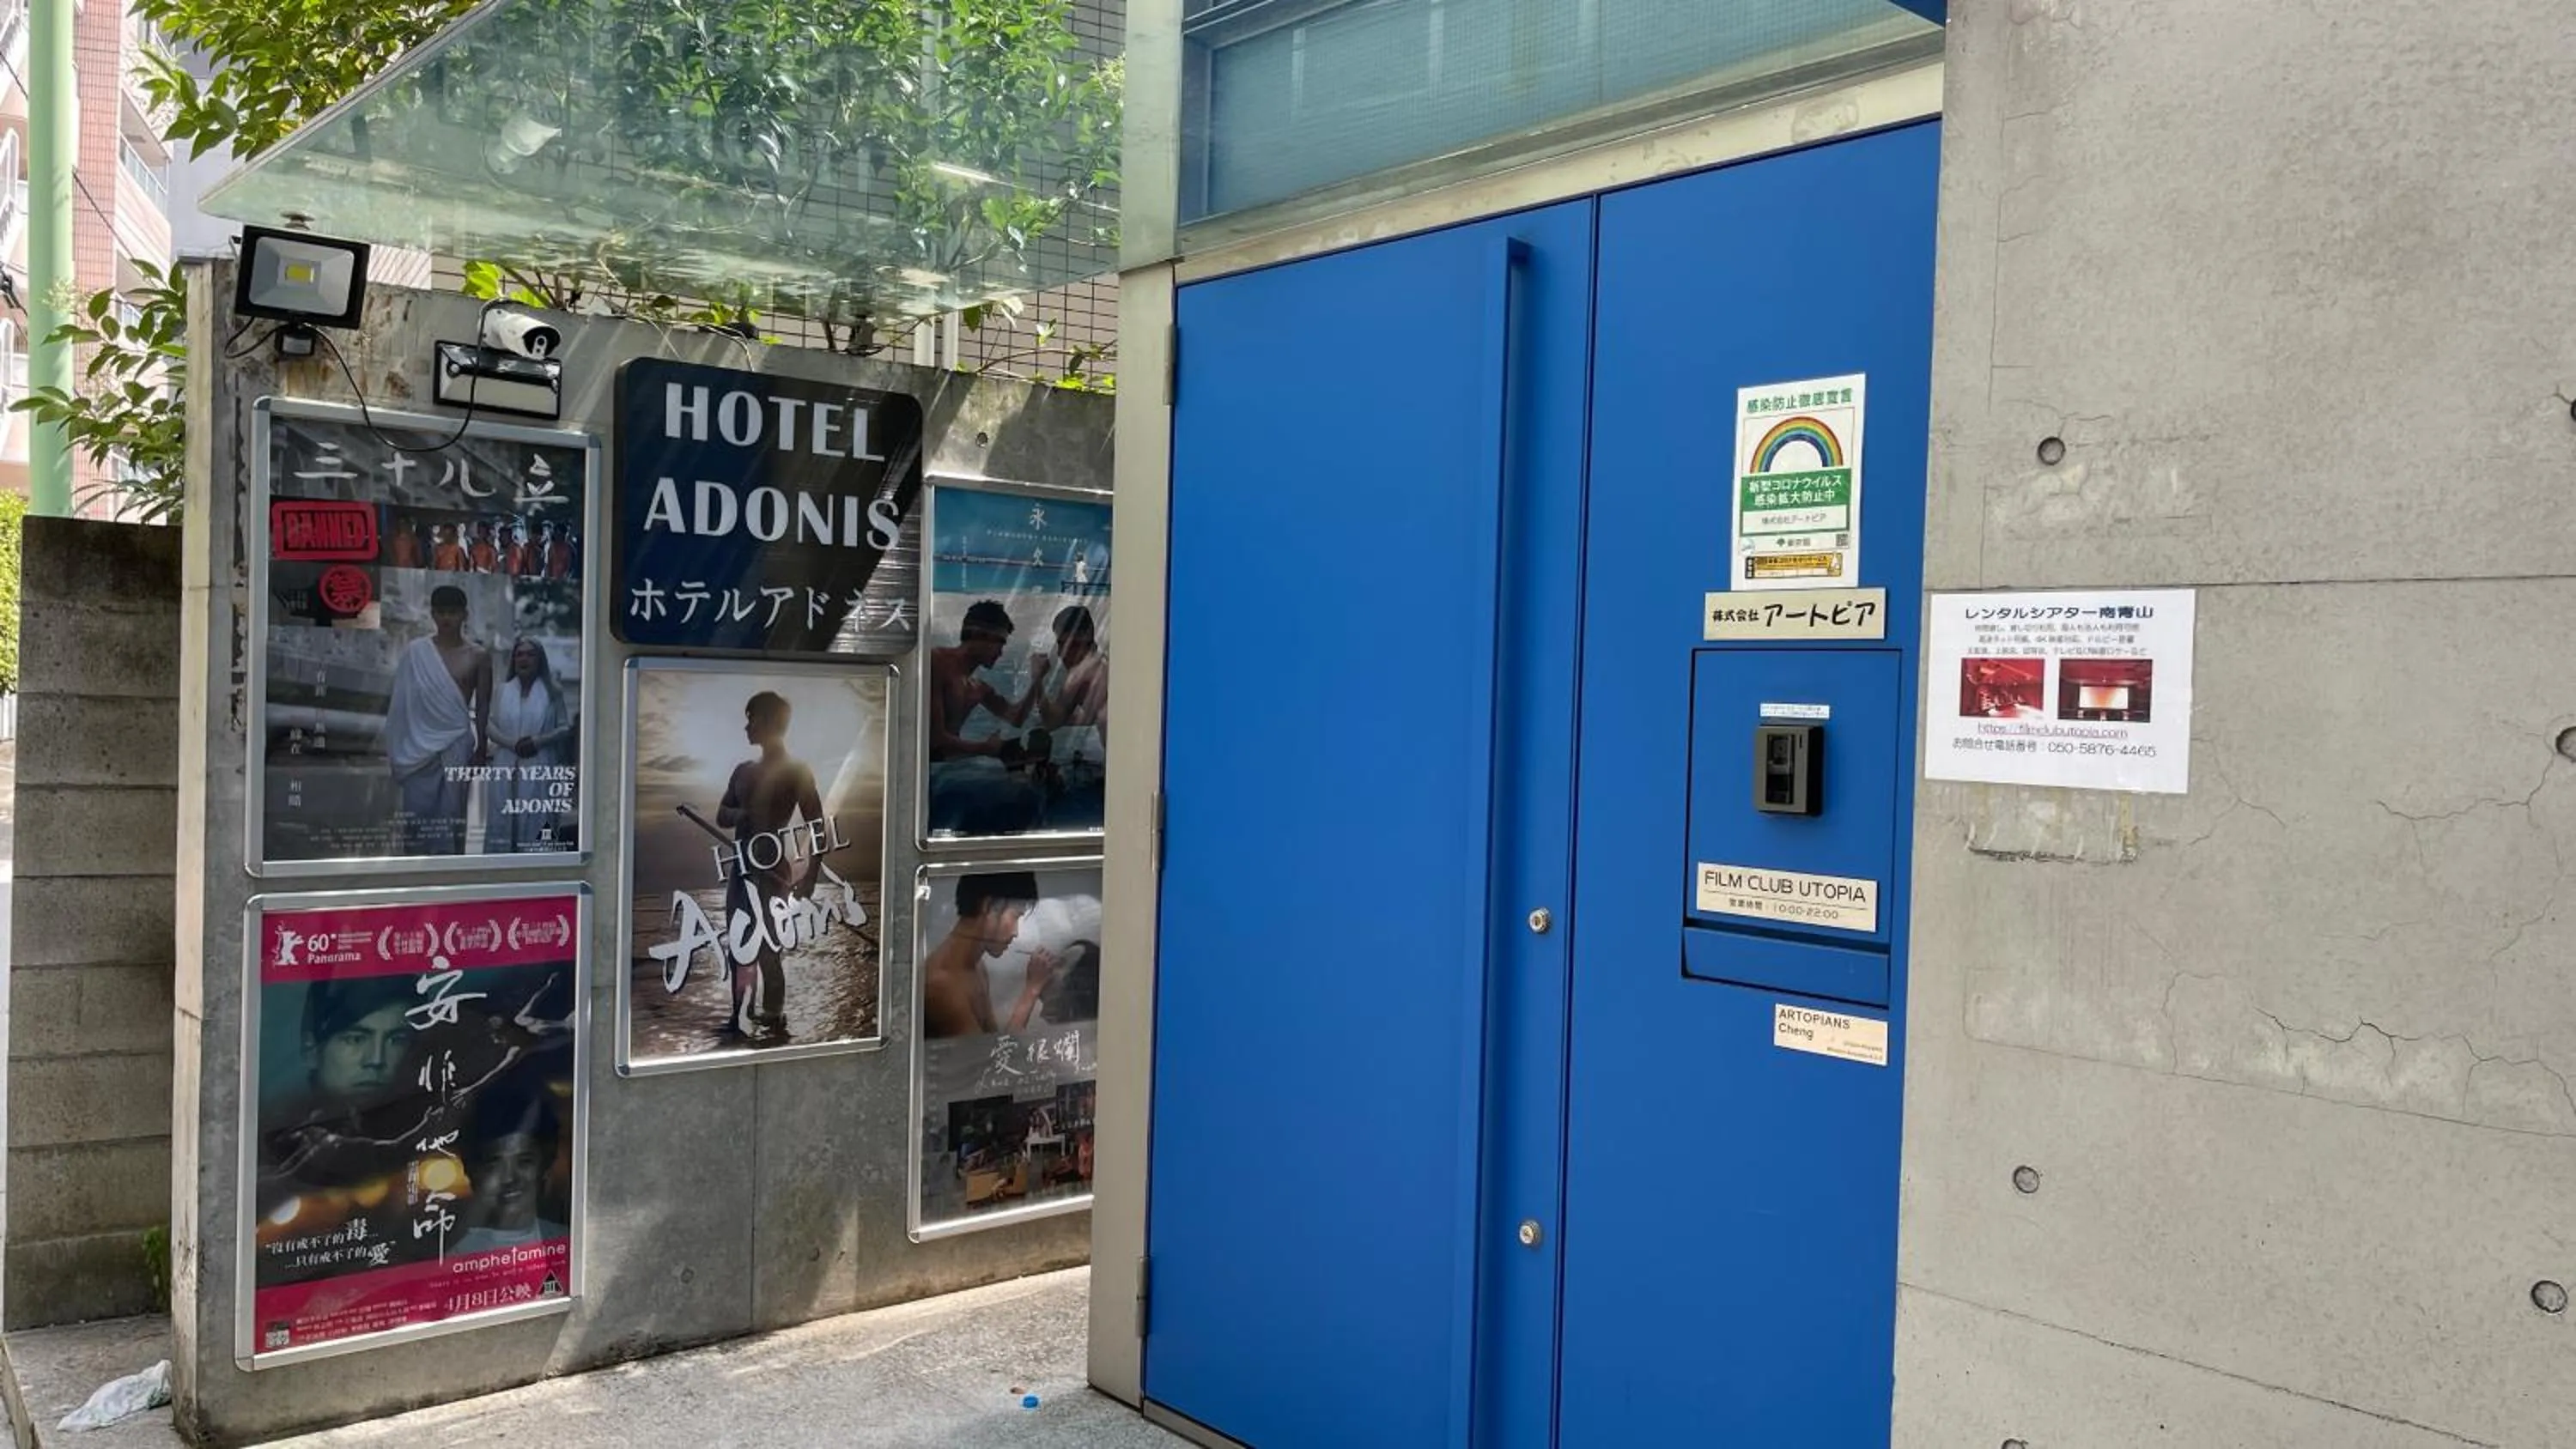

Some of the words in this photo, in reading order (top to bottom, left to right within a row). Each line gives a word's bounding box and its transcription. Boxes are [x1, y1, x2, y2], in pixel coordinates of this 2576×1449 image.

[1747, 388, 1852, 414] 感染防止徹底宣言
[665, 383, 884, 461] HOTEL
[1749, 475, 1842, 494] 新型コロナウイルス
[1754, 490, 1835, 506] 感染拡大防止中
[643, 477, 901, 550] ADONIS
[1712, 609, 1759, 622] 株式会社
[1764, 600, 1876, 627] アートピア
[1965, 605, 2154, 621] レンタルシアター南青山
[445, 765, 516, 782] THIRTY
[518, 765, 577, 781] YEARS
[549, 782, 574, 797] OF
[501, 798, 573, 815] ADONIS
[711, 815, 851, 882] HOTEL
[1704, 870, 1742, 889] FILM
[1747, 875, 1794, 894] CLUB
[1799, 880, 1867, 903] UTOPIA
[307, 952, 361, 964] Panorama
[1778, 1009, 1850, 1029] ARTOPIANS
[1778, 1022, 1814, 1040] Cheng
[453, 1245, 566, 1273] amphetamine
